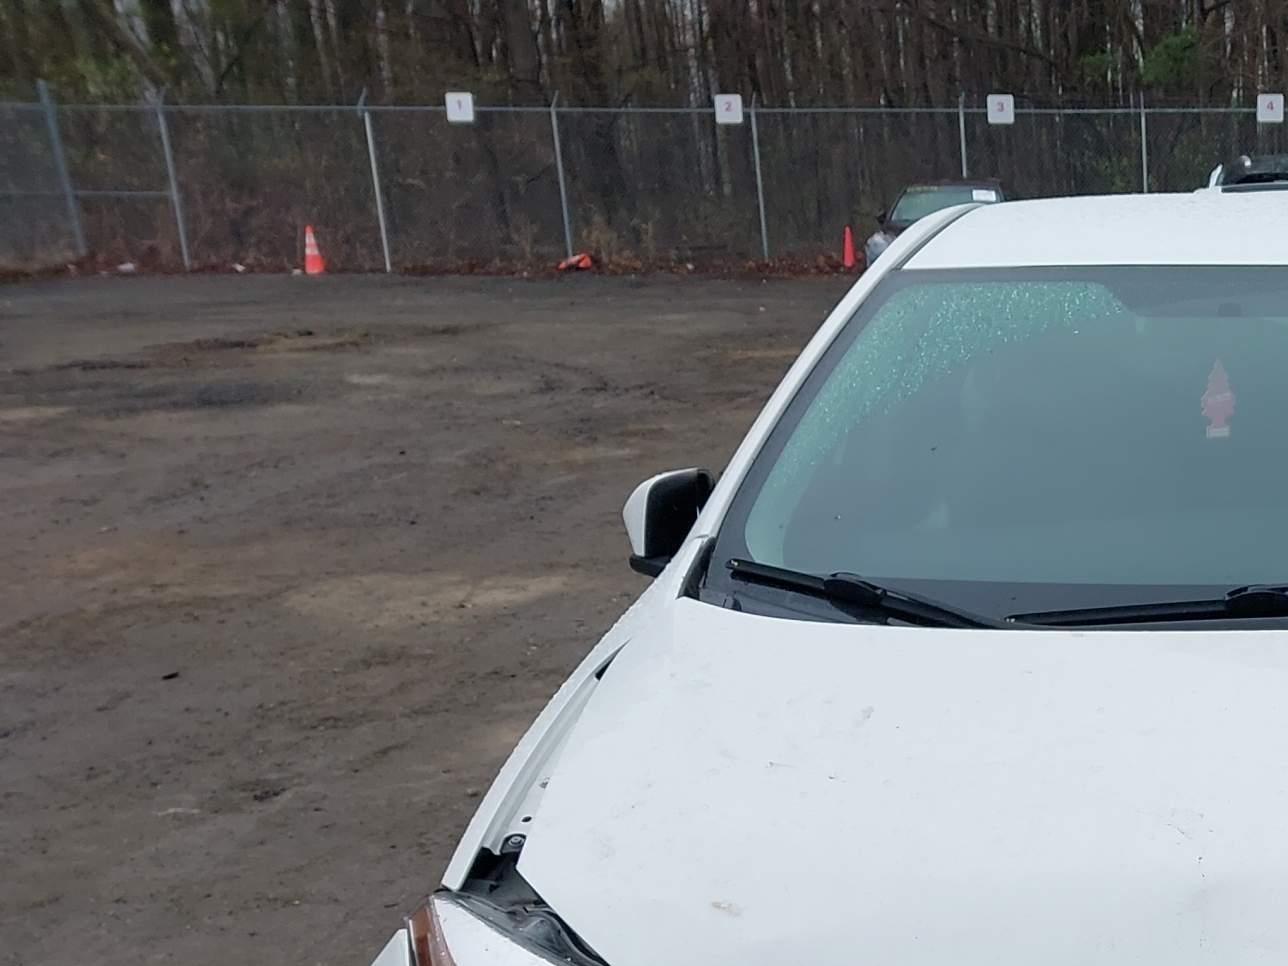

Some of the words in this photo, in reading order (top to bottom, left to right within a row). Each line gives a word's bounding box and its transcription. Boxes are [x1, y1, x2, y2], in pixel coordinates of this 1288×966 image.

[457, 99, 462, 111] 1
[724, 101, 733, 112] 2
[996, 101, 1005, 112] 3
[1266, 101, 1274, 111] 4
